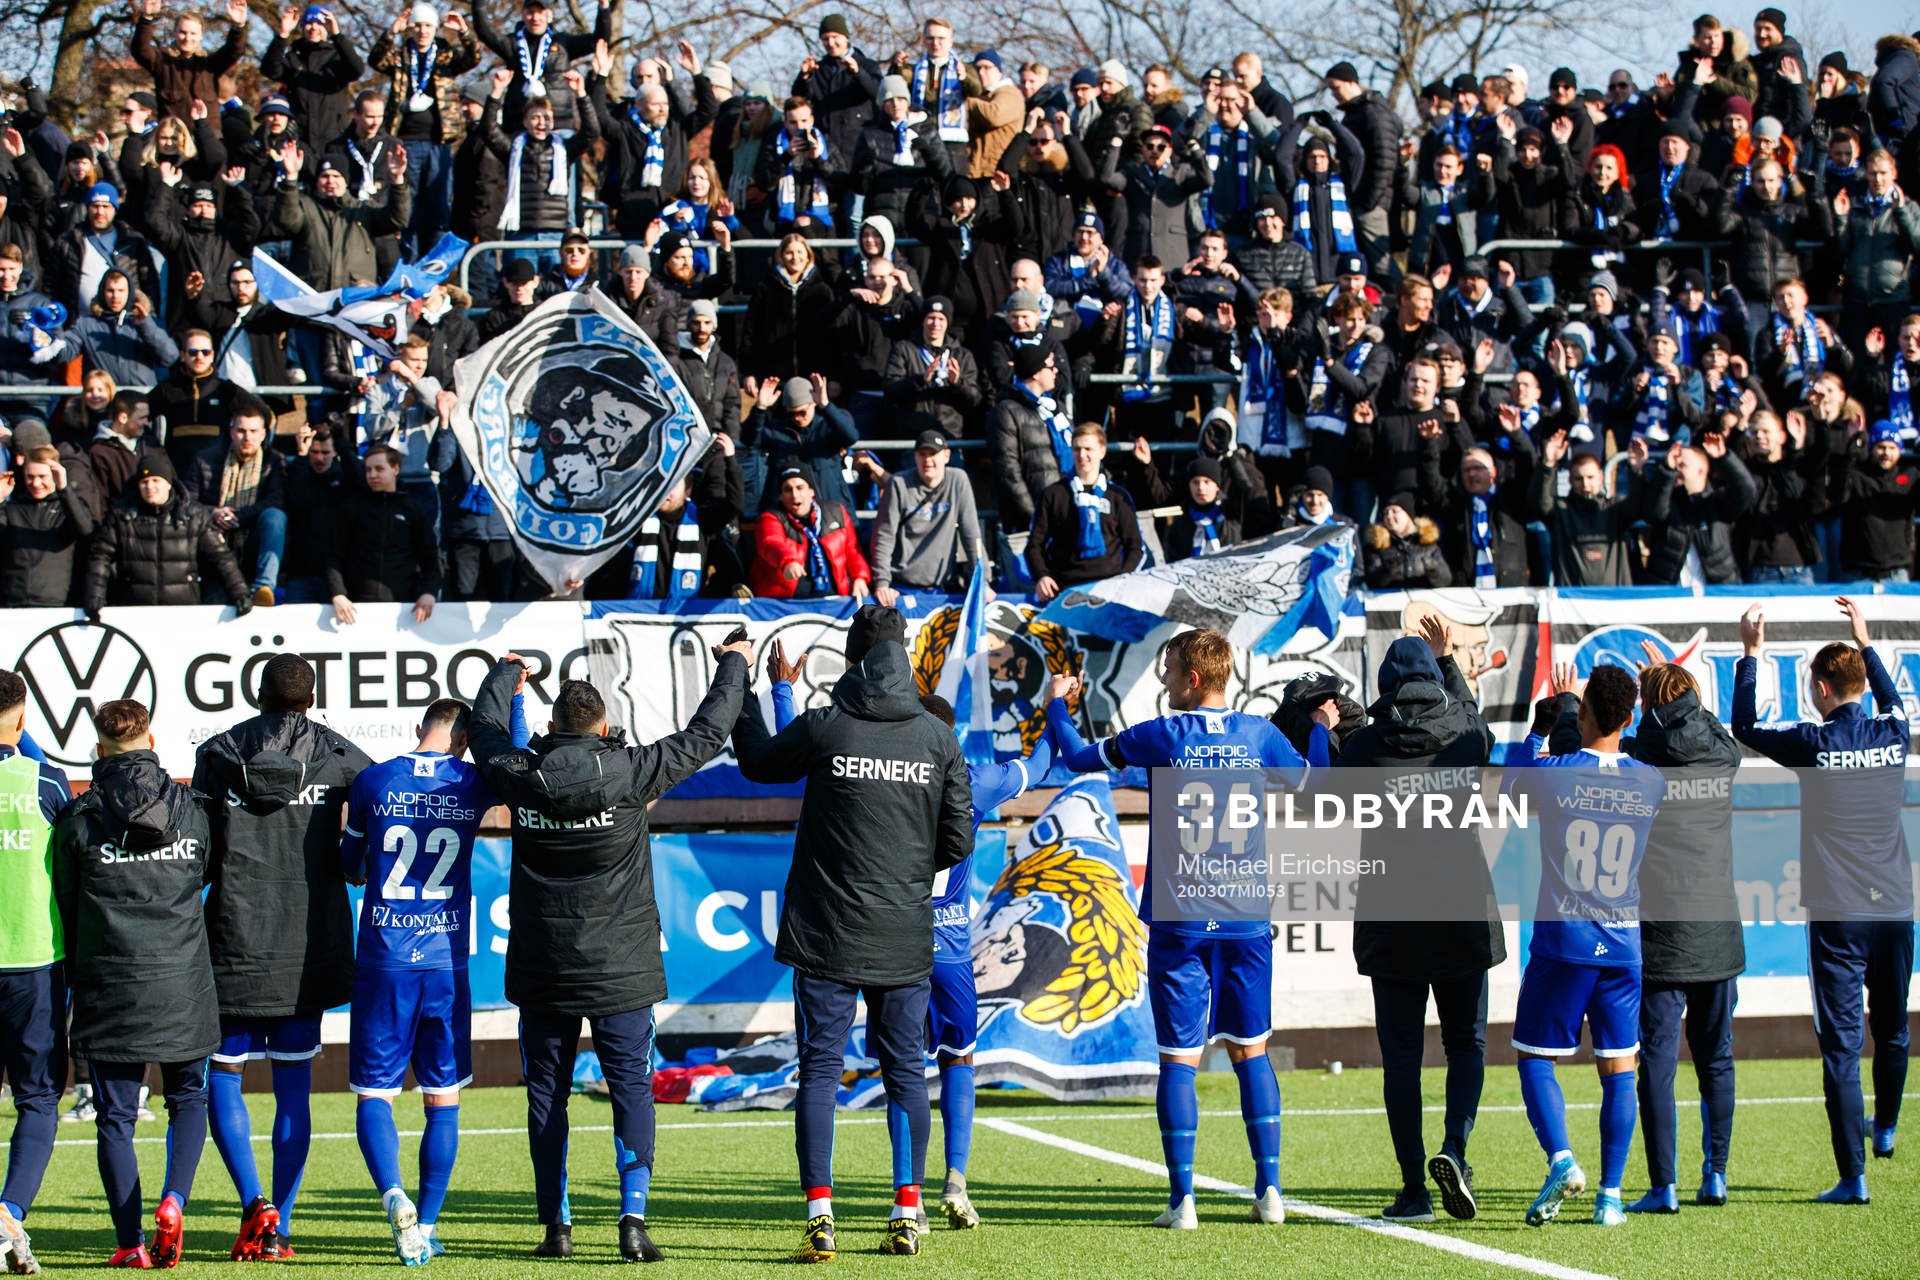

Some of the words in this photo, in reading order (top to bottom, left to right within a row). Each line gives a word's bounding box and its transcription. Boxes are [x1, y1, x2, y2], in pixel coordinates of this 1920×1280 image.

[184, 634, 589, 713] GÖTEBOR
[1184, 745, 1249, 758] NORDIC
[1816, 743, 1904, 771] SERNEKE
[831, 755, 932, 785] SERNEKE
[1169, 758, 1261, 770] WELLNESS
[1383, 765, 1477, 796] SERNEKE
[1663, 777, 1731, 800] RNEKE
[387, 791, 458, 807] NORDIC
[1574, 784, 1642, 803] NORDIC
[373, 804, 475, 821] WELLNESS
[1556, 795, 1654, 817] WELLNESS
[1180, 781, 1251, 855] 34
[381, 825, 461, 900] 22
[1563, 819, 1636, 899] 89
[392, 910, 460, 928] KONTAKT
[933, 904, 966, 920] TAKT
